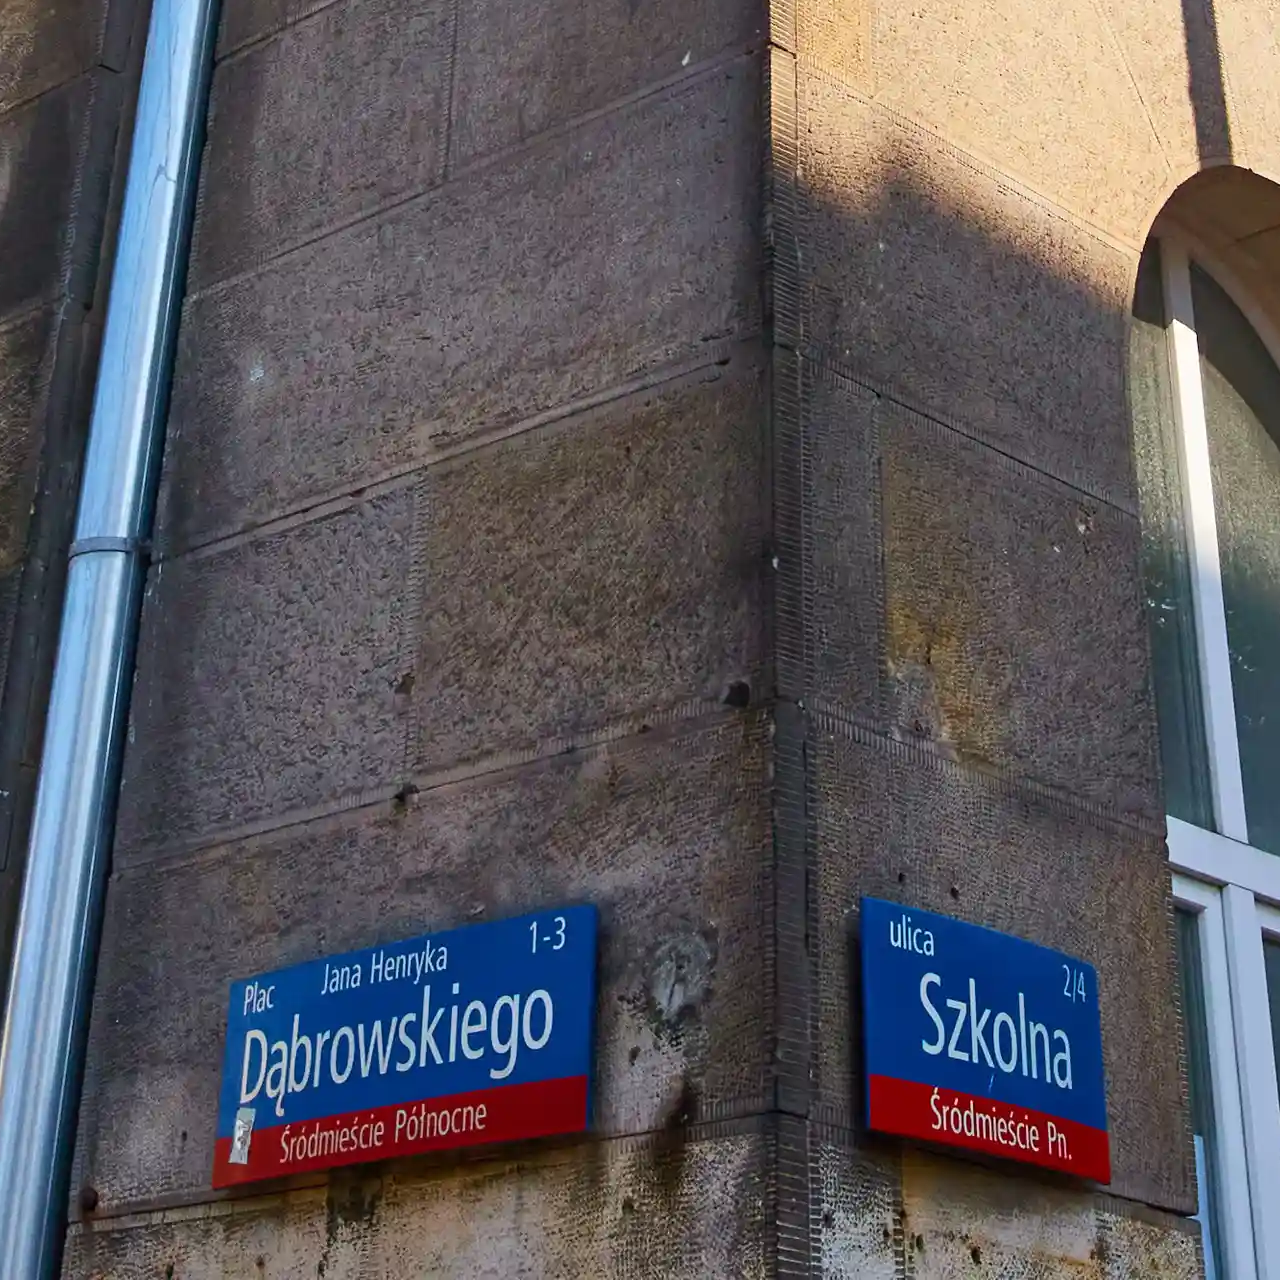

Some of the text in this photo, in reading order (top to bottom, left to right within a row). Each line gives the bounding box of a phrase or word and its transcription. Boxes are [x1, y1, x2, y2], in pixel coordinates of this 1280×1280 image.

[529, 916, 566, 953] 1-3
[890, 914, 934, 956] ulica
[321, 940, 448, 995] Jana Henryka
[1063, 964, 1086, 1003] 2/4
[243, 982, 275, 1015] Plac
[240, 983, 553, 1116] Dąbrowskiego
[920, 972, 1073, 1089] Szkolna
[280, 1103, 487, 1163] Śródmieście Północne
[930, 1087, 1072, 1160] Śródmieście Pn.
